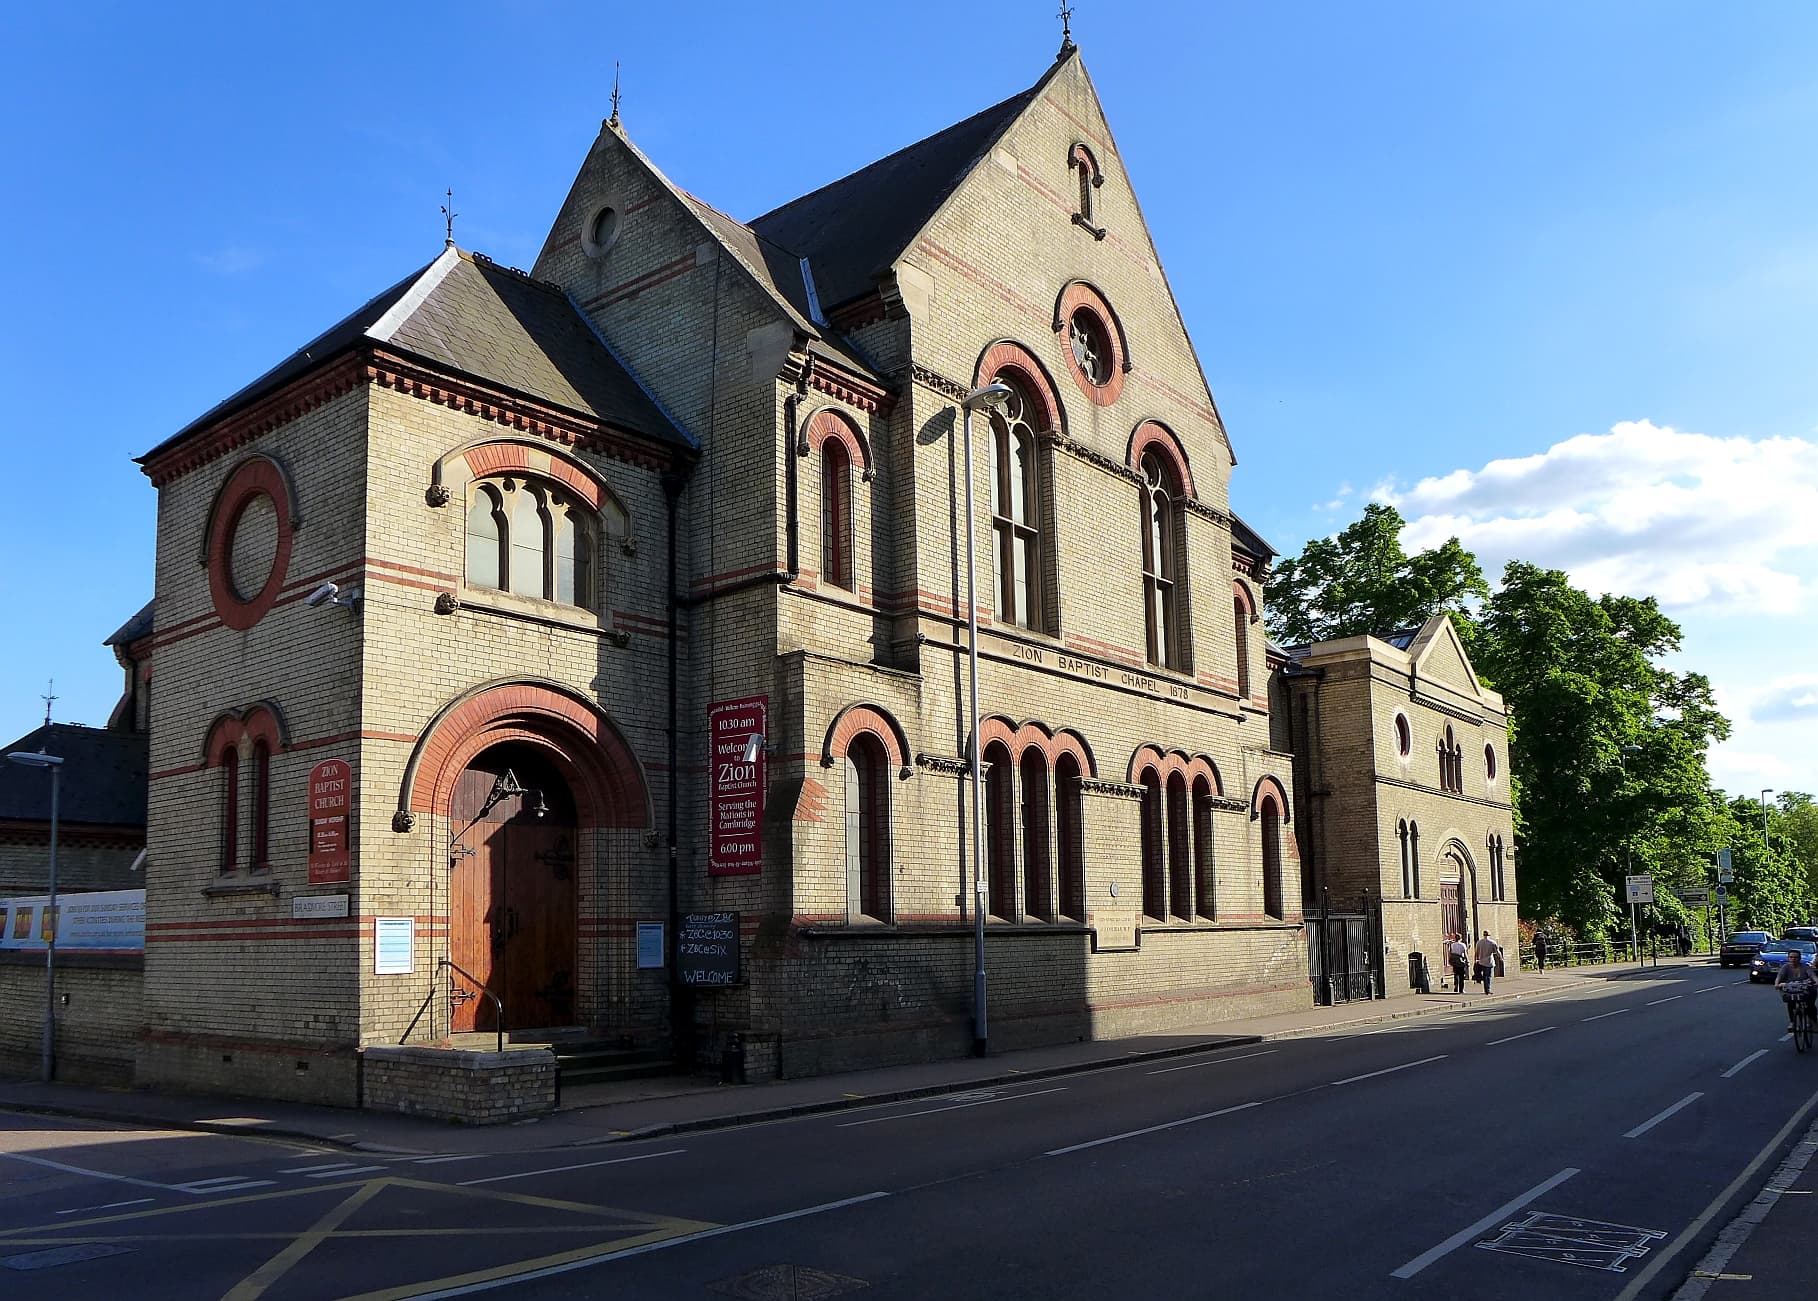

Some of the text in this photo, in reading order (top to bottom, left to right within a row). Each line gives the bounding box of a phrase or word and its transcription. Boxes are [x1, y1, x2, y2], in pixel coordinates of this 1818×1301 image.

[1012, 645, 1189, 699] ZION BAPTIST CHAPEL 1878
[740, 717, 755, 728] am
[718, 742, 751, 755] Welco
[321, 764, 338, 777] ZION
[718, 763, 756, 783] Zion
[315, 779, 344, 793] BAPTIST
[718, 780, 757, 792] Baptist Church
[315, 795, 344, 809] CHURCH
[718, 799, 757, 811] Serving the
[720, 809, 755, 820] Nations in
[719, 818, 756, 830] Cambridge
[739, 843, 755, 855] pm
[684, 970, 733, 983] WELCOME
